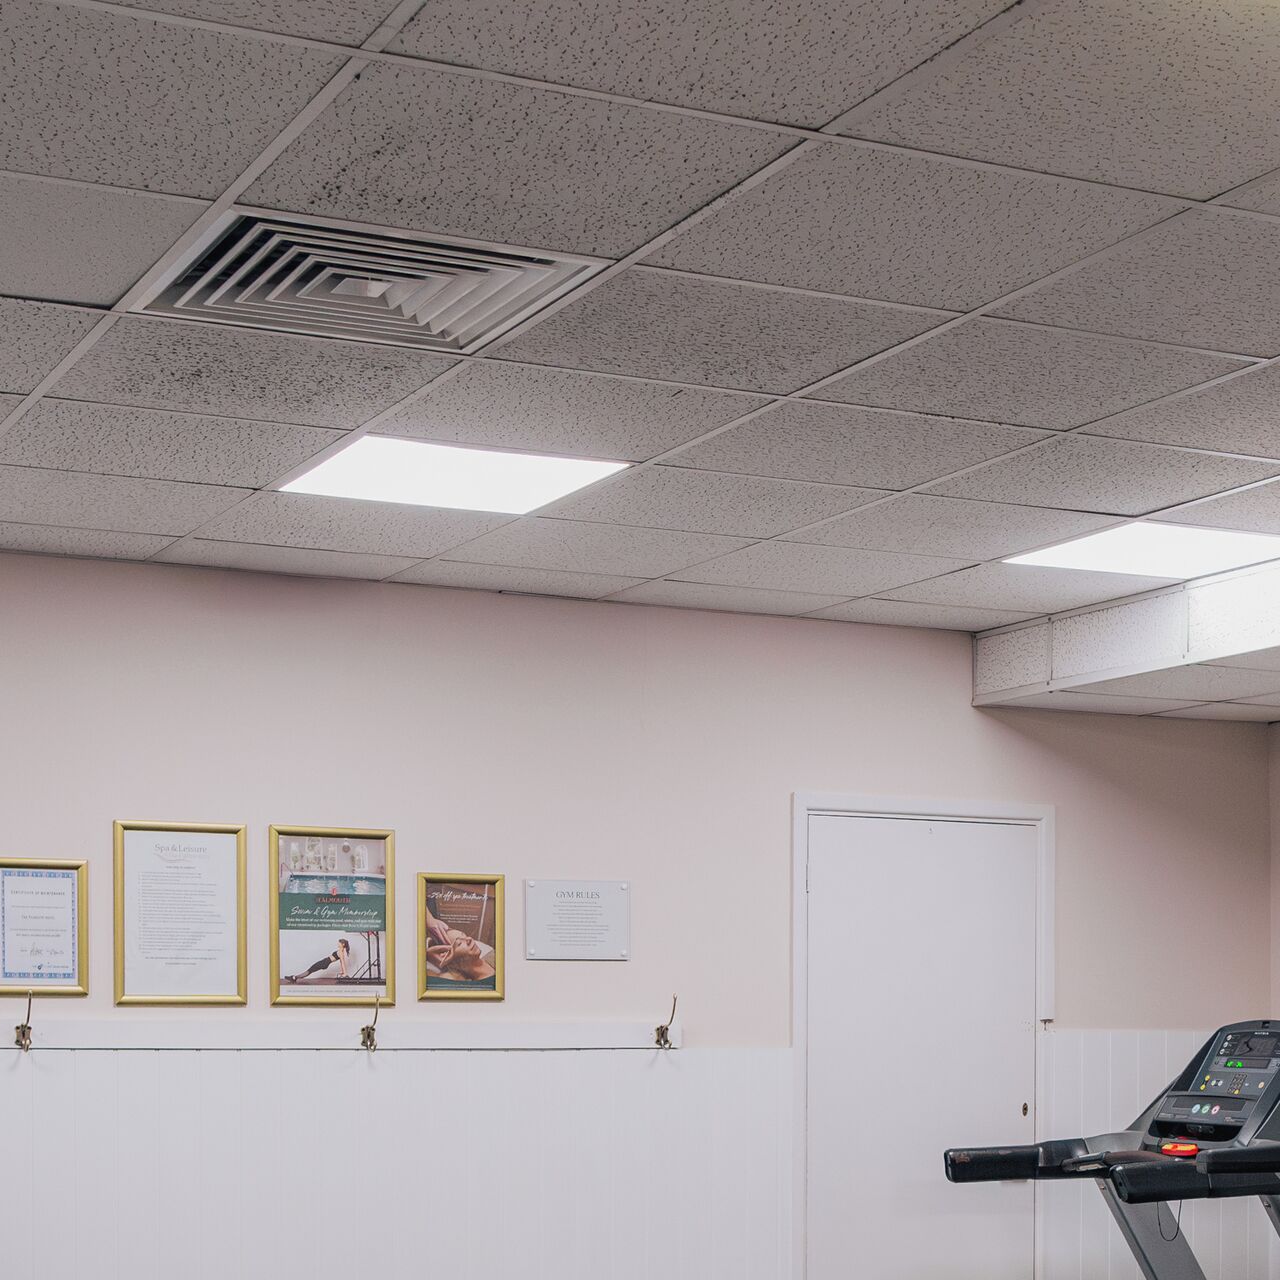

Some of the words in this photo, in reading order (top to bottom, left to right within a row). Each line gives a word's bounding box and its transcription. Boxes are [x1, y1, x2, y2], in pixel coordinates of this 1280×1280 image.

[154, 843, 169, 854] Spa
[178, 844, 208, 853] Leisure
[555, 891, 574, 899] GYM
[576, 891, 601, 899] RULES
[321, 905, 338, 918] Gym
